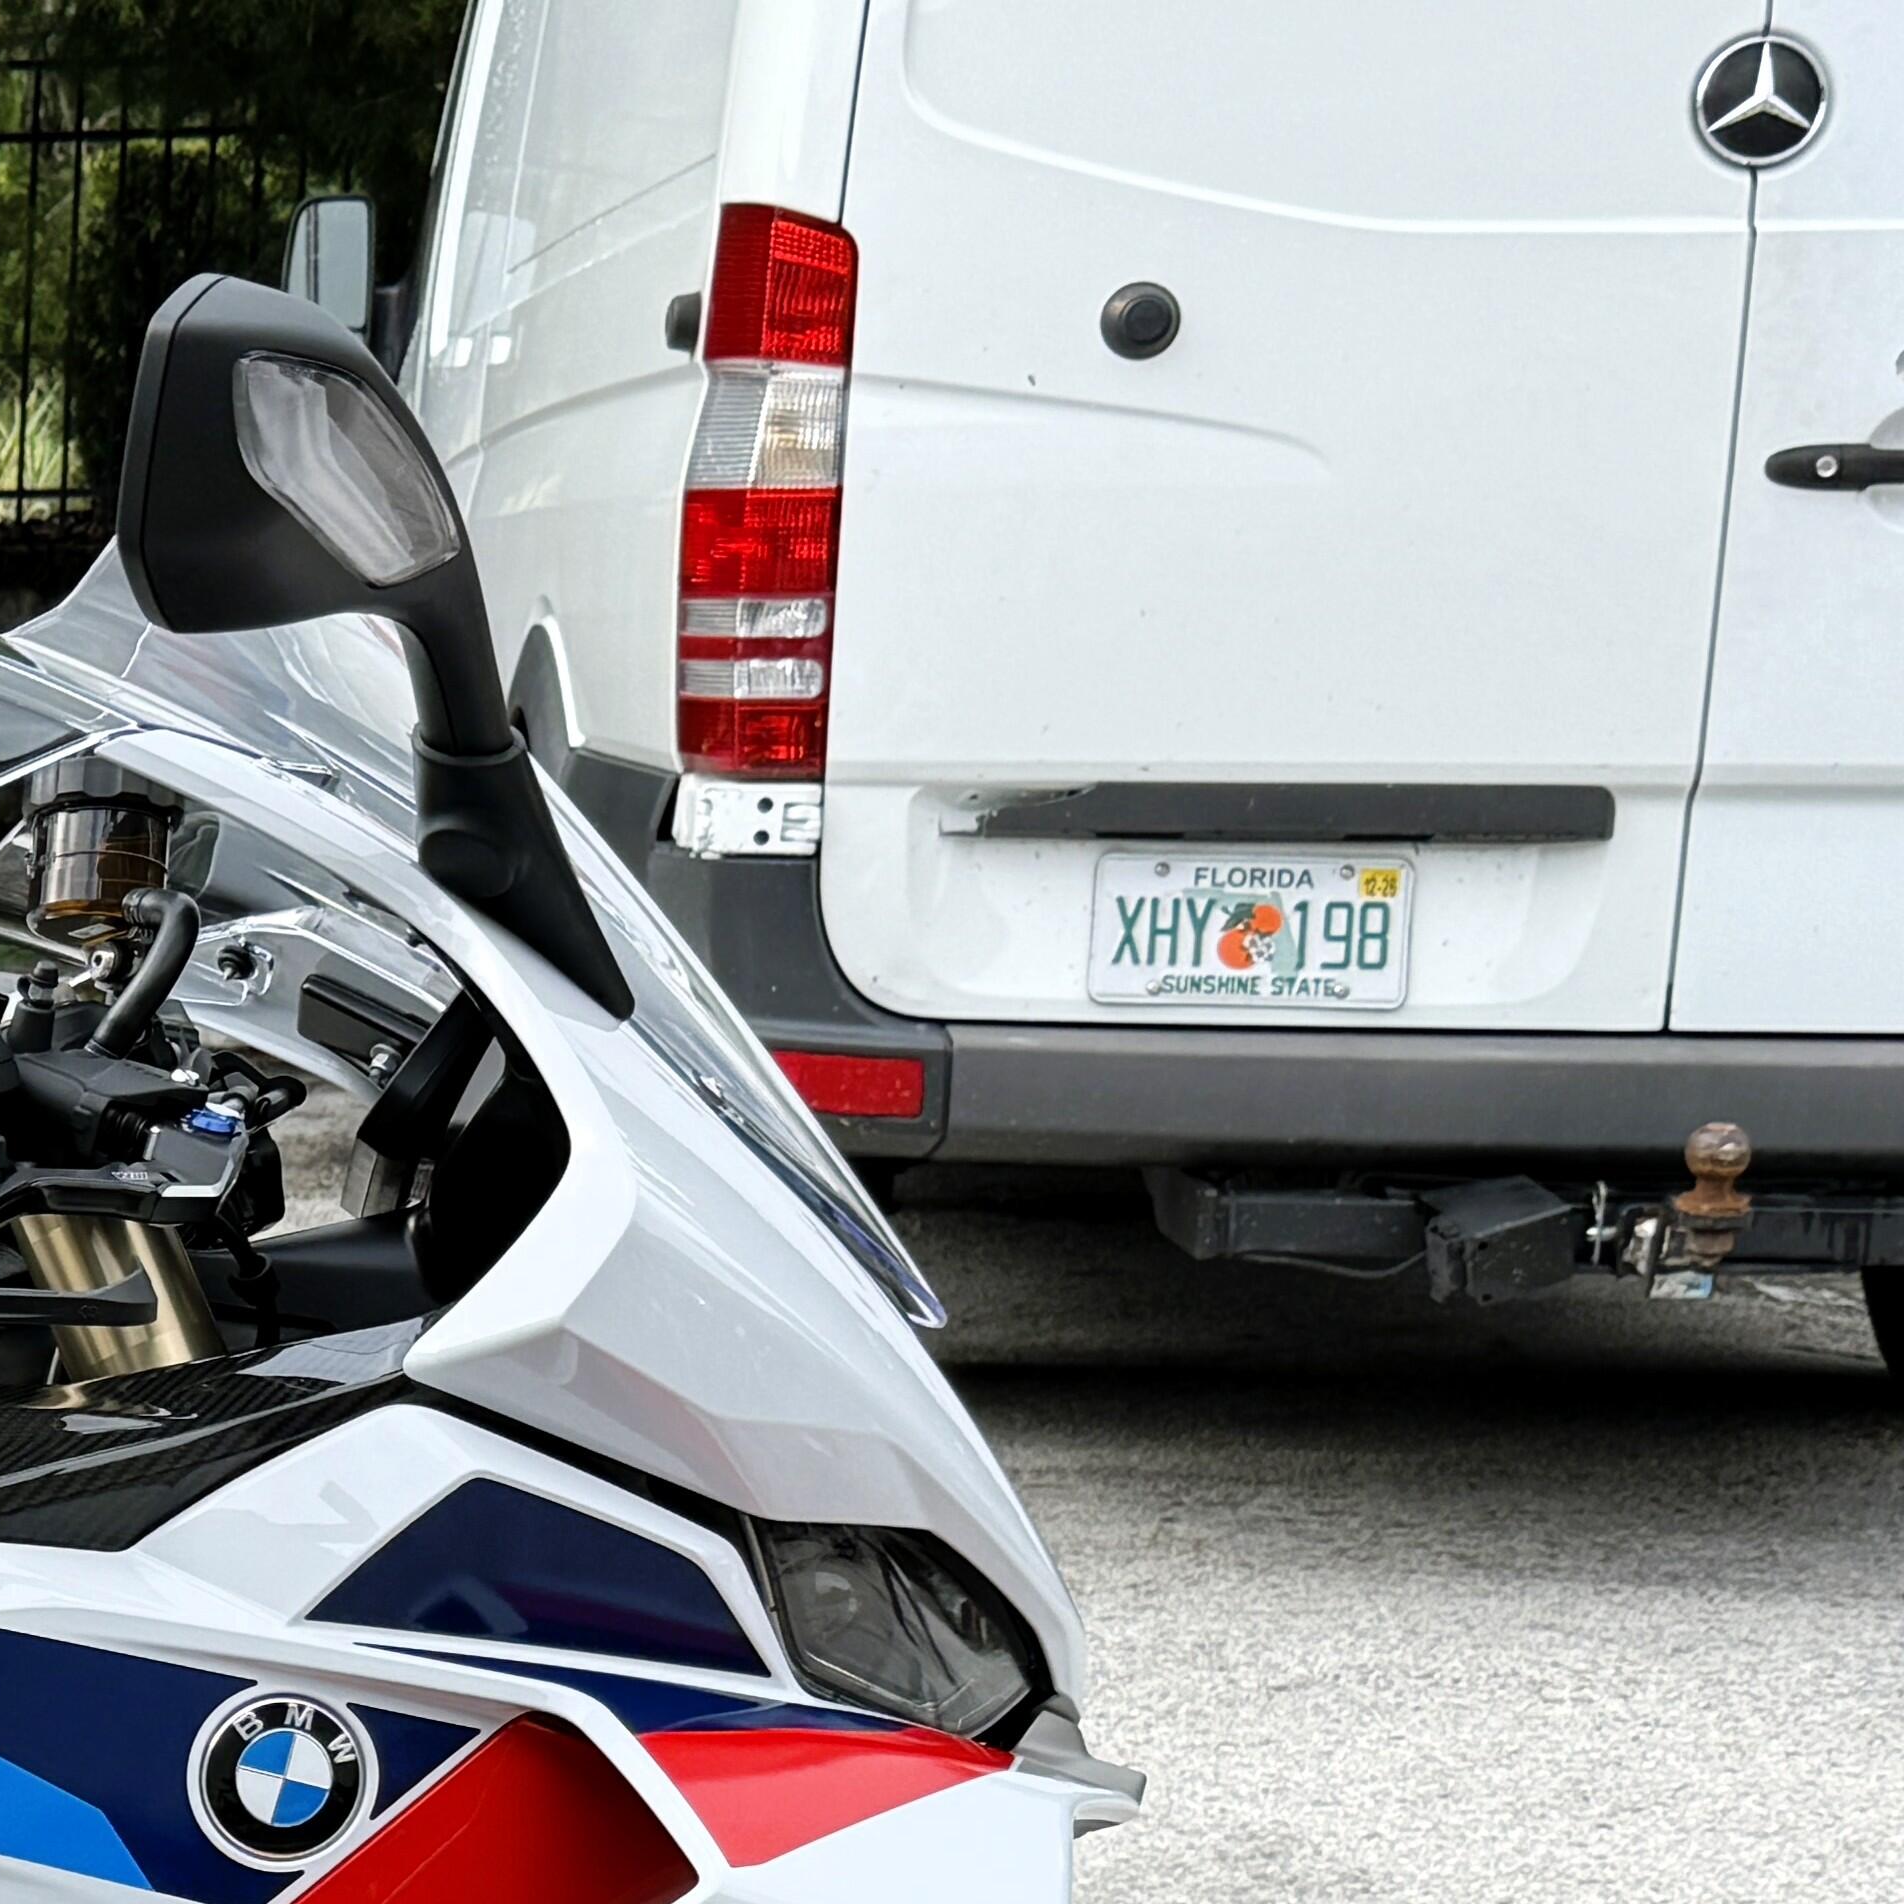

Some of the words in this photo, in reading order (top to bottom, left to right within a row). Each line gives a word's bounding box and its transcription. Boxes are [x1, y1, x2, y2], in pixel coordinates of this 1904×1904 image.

[1194, 867, 1314, 889] FLORIDA
[1111, 896, 1216, 966] XHY
[1295, 901, 1391, 970] 198
[1161, 975, 1261, 996] SUNSHINE
[1270, 976, 1336, 997] STATE
[233, 1703, 357, 1764] BMW
